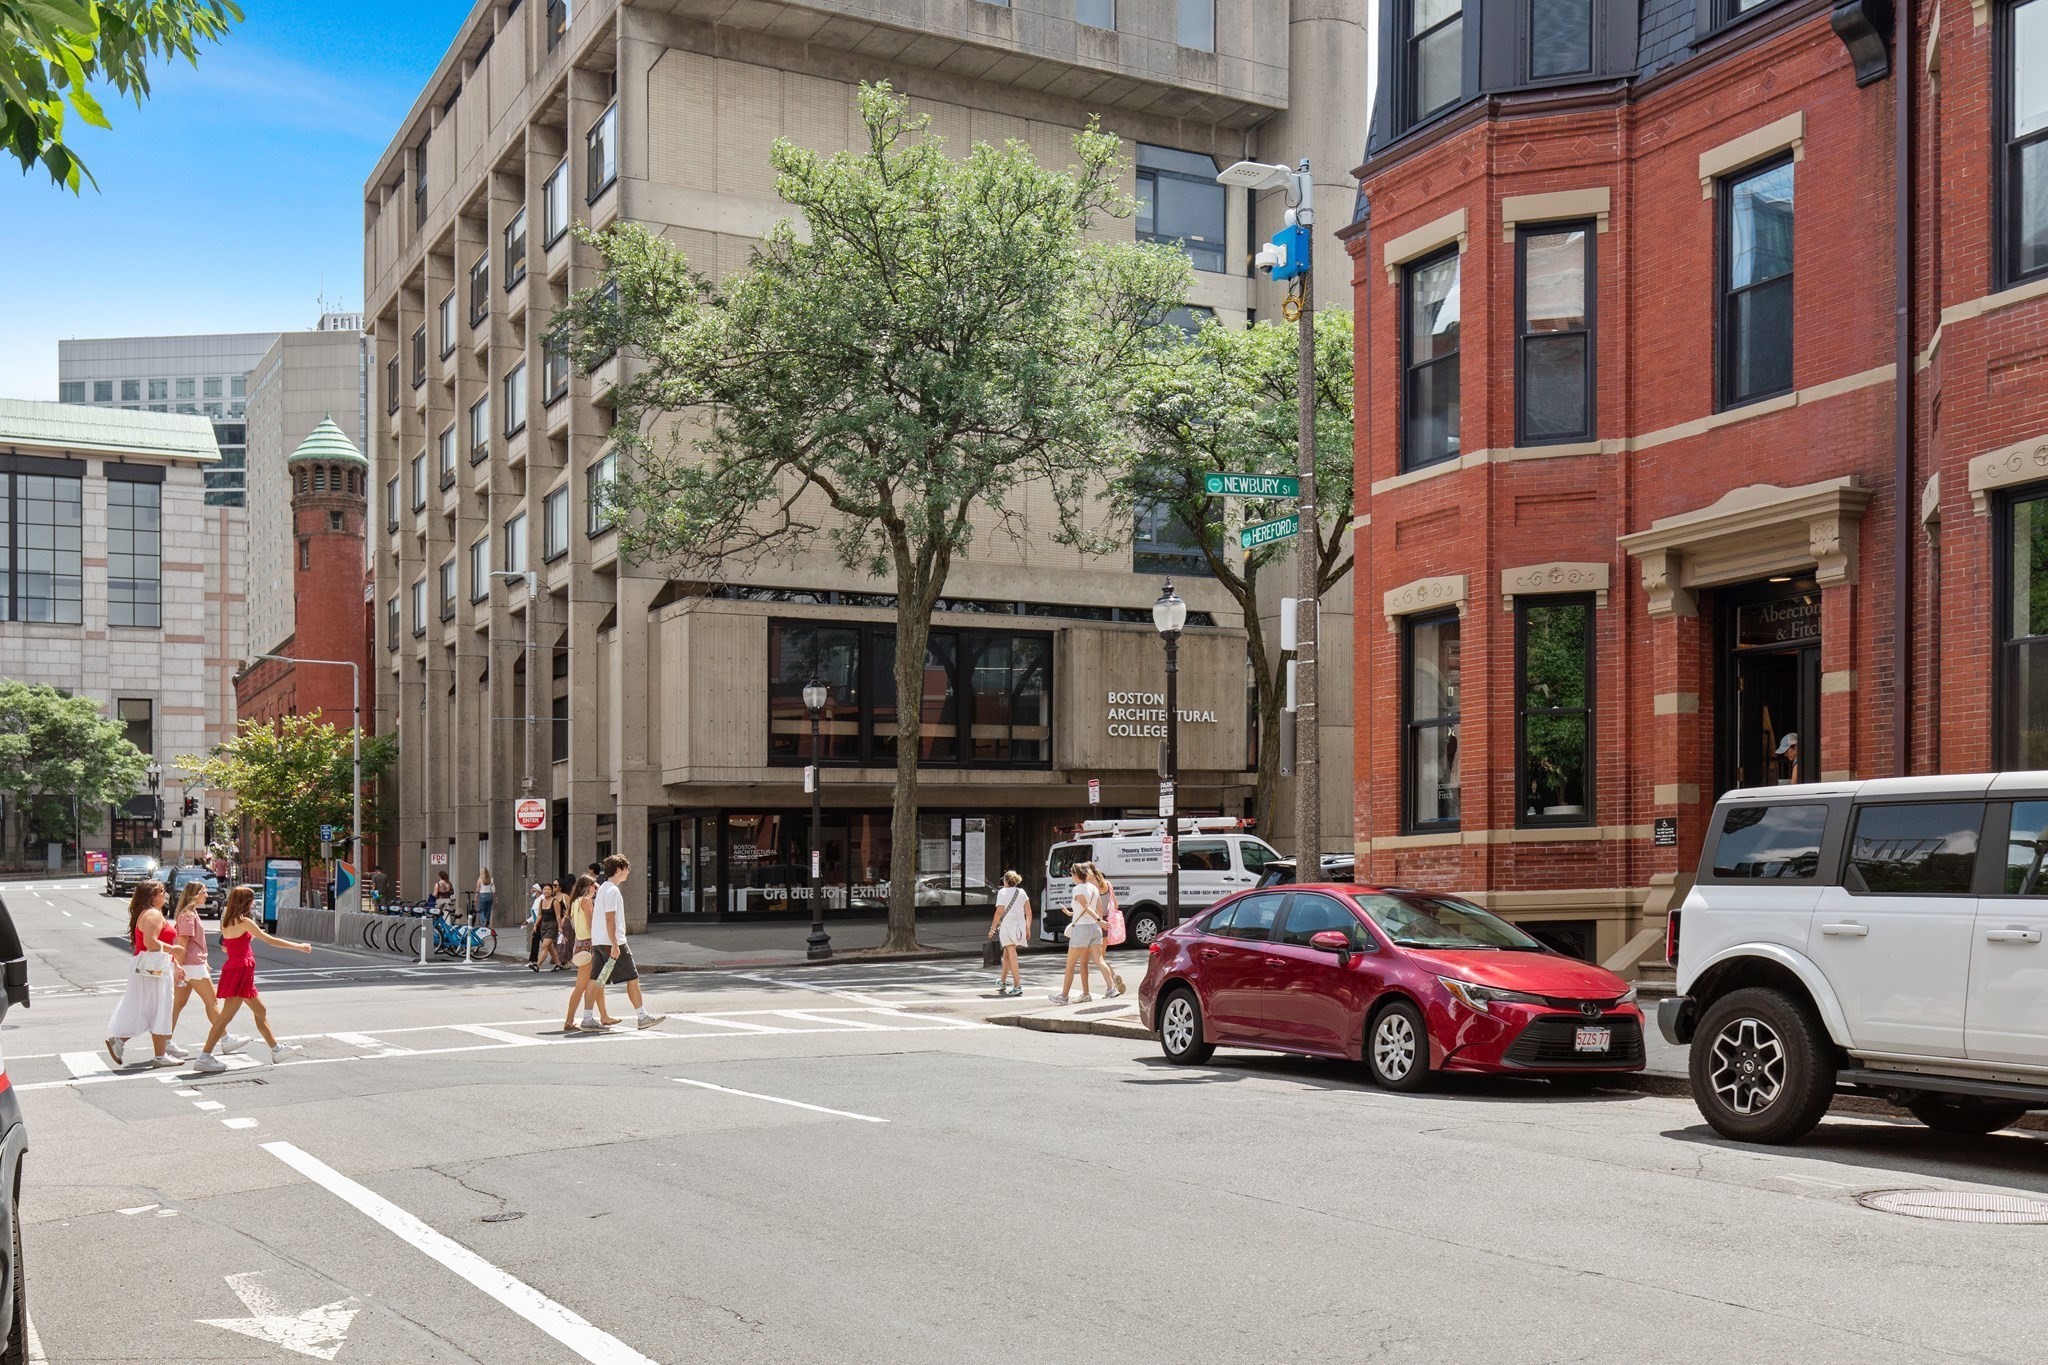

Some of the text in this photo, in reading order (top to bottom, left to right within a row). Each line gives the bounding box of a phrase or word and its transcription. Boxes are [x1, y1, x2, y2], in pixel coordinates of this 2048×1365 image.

[1224, 476, 1280, 494] NEWBURY
[1252, 519, 1292, 544] HEREFORD
[1776, 629, 1787, 640] &
[1107, 692, 1164, 705] BOSTON
[1107, 708, 1218, 722] ARCHITETURAL
[1107, 724, 1168, 737] COLLEGE
[763, 885, 842, 900] Graduaion
[1577, 1032, 1609, 1045] 5ZZS 77
